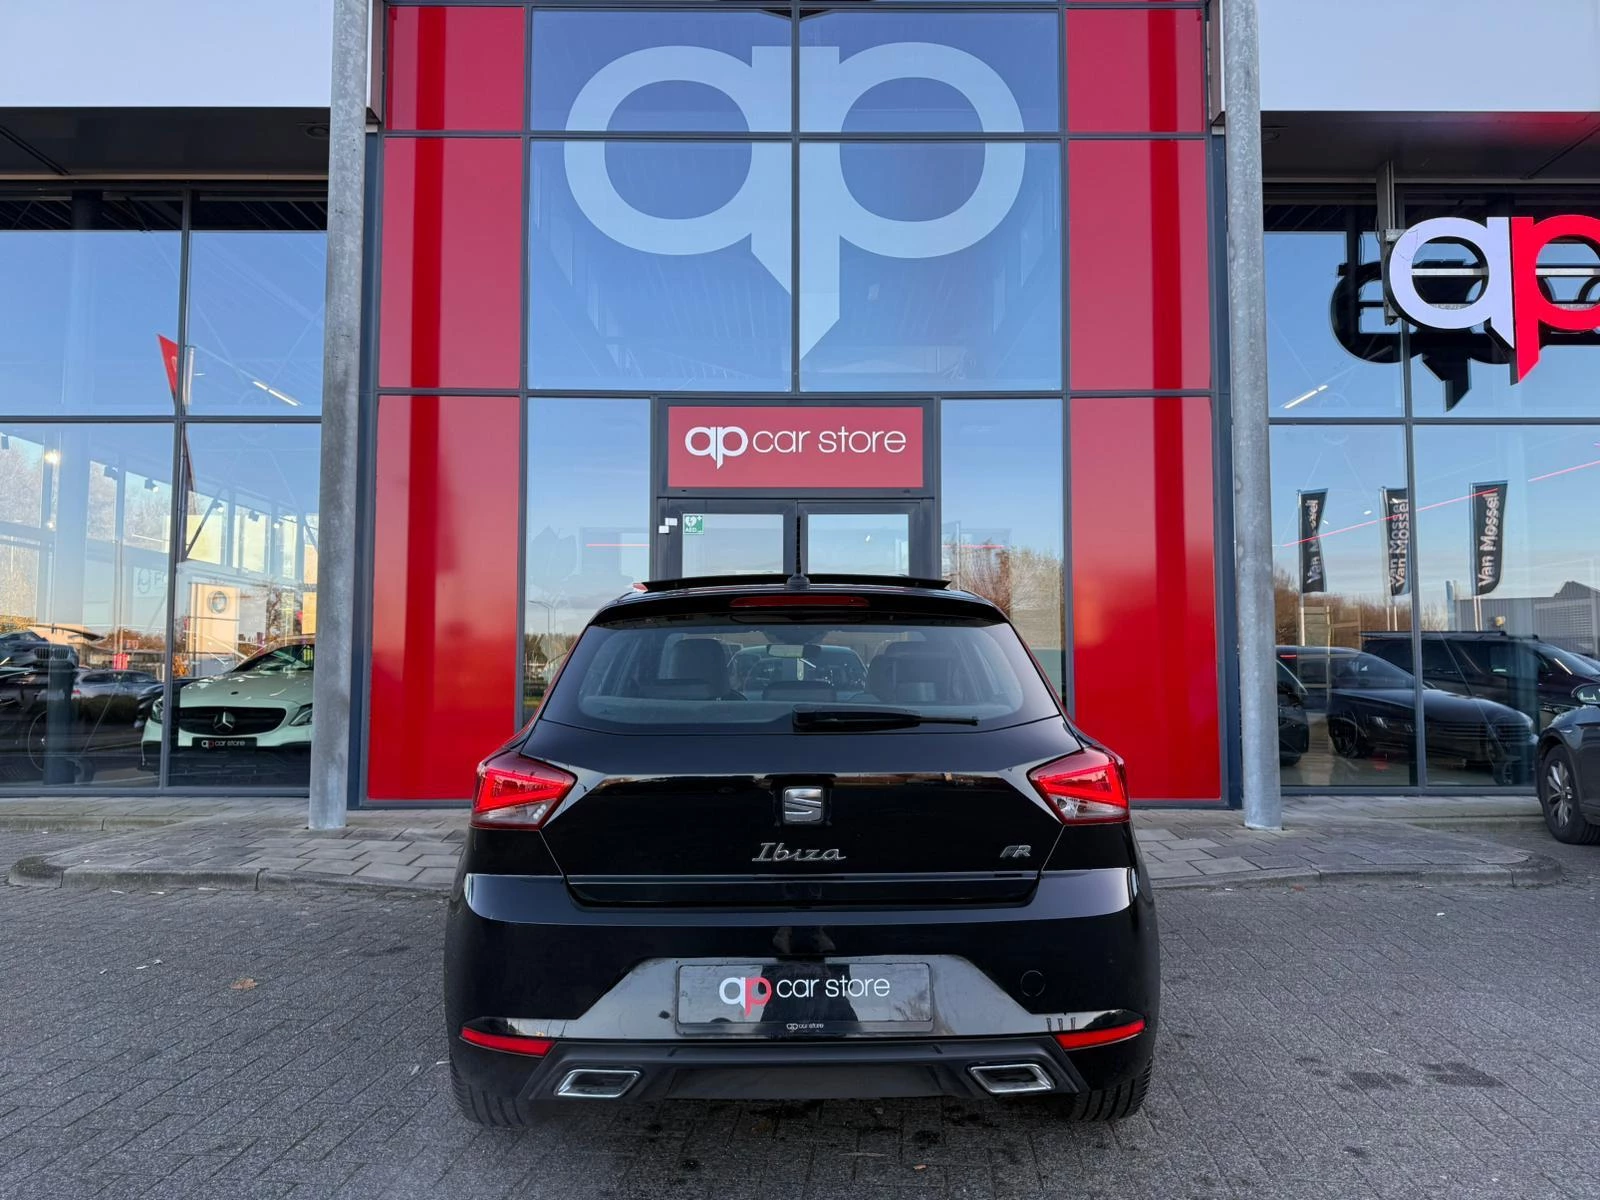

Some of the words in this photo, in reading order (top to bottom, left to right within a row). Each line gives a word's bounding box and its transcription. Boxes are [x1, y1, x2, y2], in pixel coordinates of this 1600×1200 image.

[684, 426, 749, 470] ap
[752, 430, 811, 453] car
[818, 425, 907, 453] store
[1480, 491, 1500, 551] Mossel
[1478, 555, 1495, 587] Van
[751, 842, 847, 862] Ibiza
[718, 976, 772, 1017] ap
[776, 978, 817, 998] car
[825, 974, 890, 998] store
